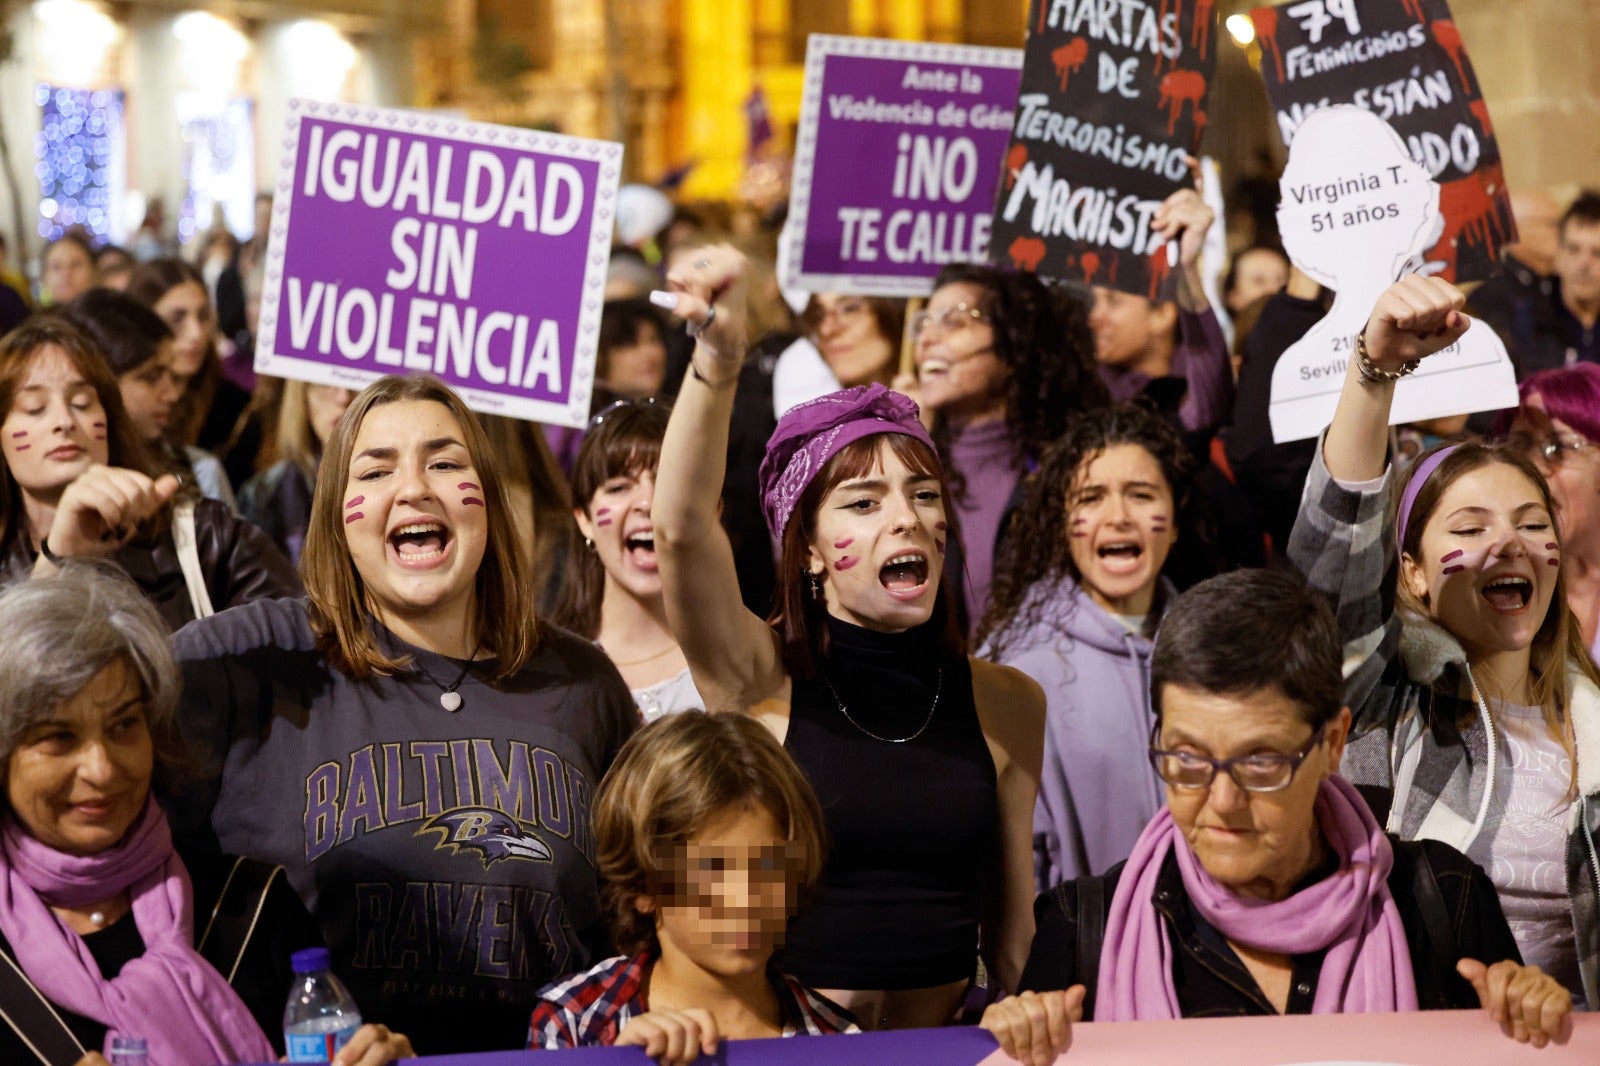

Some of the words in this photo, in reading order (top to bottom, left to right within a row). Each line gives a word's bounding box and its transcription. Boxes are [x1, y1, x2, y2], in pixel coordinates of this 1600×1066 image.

[1047, 0, 1182, 59] HARTAS
[902, 65, 958, 92] Ante
[960, 68, 984, 95] la
[1098, 51, 1140, 98] DE
[828, 94, 934, 126] Violencia
[937, 102, 967, 127] de
[969, 104, 1015, 130] Gén
[304, 125, 584, 236] IGUALDAD
[893, 132, 978, 202] ¡NO
[1291, 172, 1382, 204] Virginia
[1387, 165, 1408, 185] T.
[838, 207, 882, 260] TE
[885, 208, 993, 265] CALLE
[1311, 211, 1335, 233] 51
[1343, 202, 1400, 228] años
[386, 217, 478, 299] SIN
[287, 277, 562, 393] VIOLENCIA
[1300, 359, 1347, 380] Sevill
[303, 738, 597, 868] BALTIMOR
[352, 882, 574, 980] RAVENS
